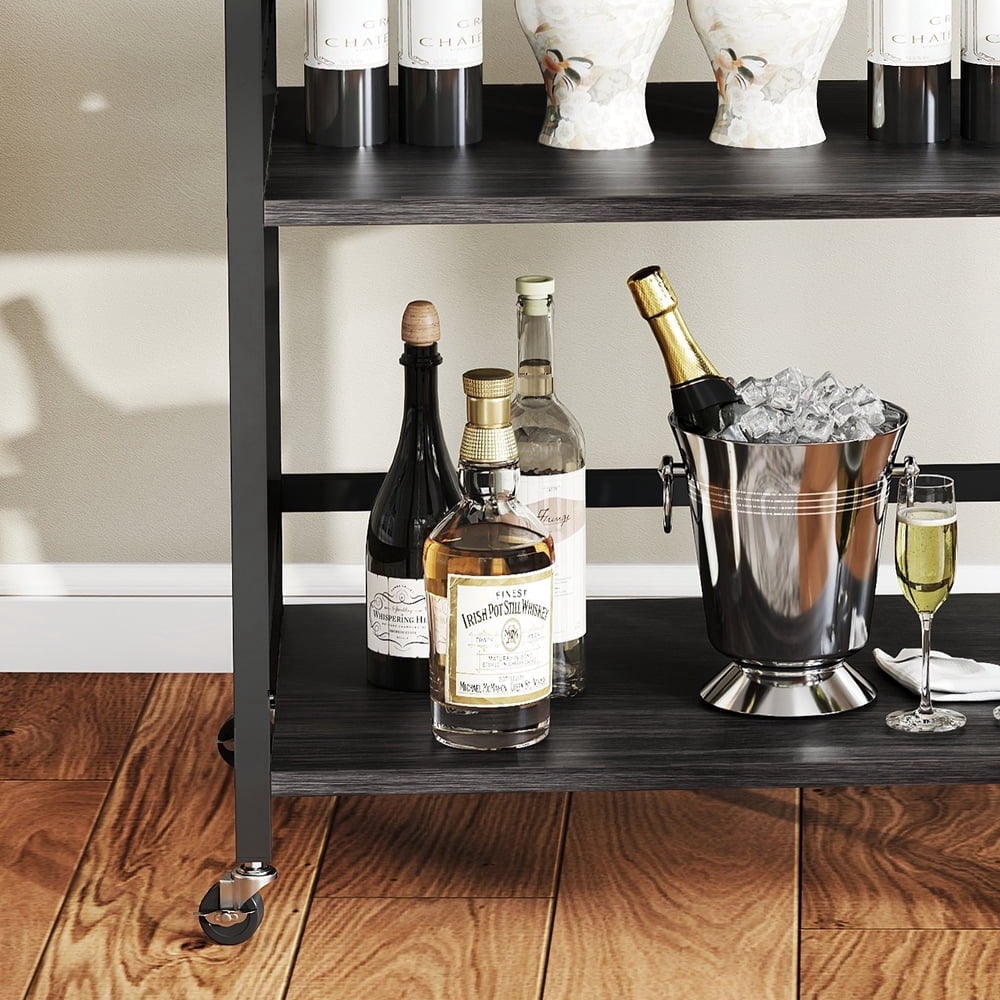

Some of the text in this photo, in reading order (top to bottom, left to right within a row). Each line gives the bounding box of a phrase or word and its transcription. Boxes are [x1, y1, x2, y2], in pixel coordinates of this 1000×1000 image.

[495, 588, 527, 599] FINEST
[373, 610, 414, 623] WHISPERING
[461, 599, 549, 629] IRISH POT STILL WHISKEY
